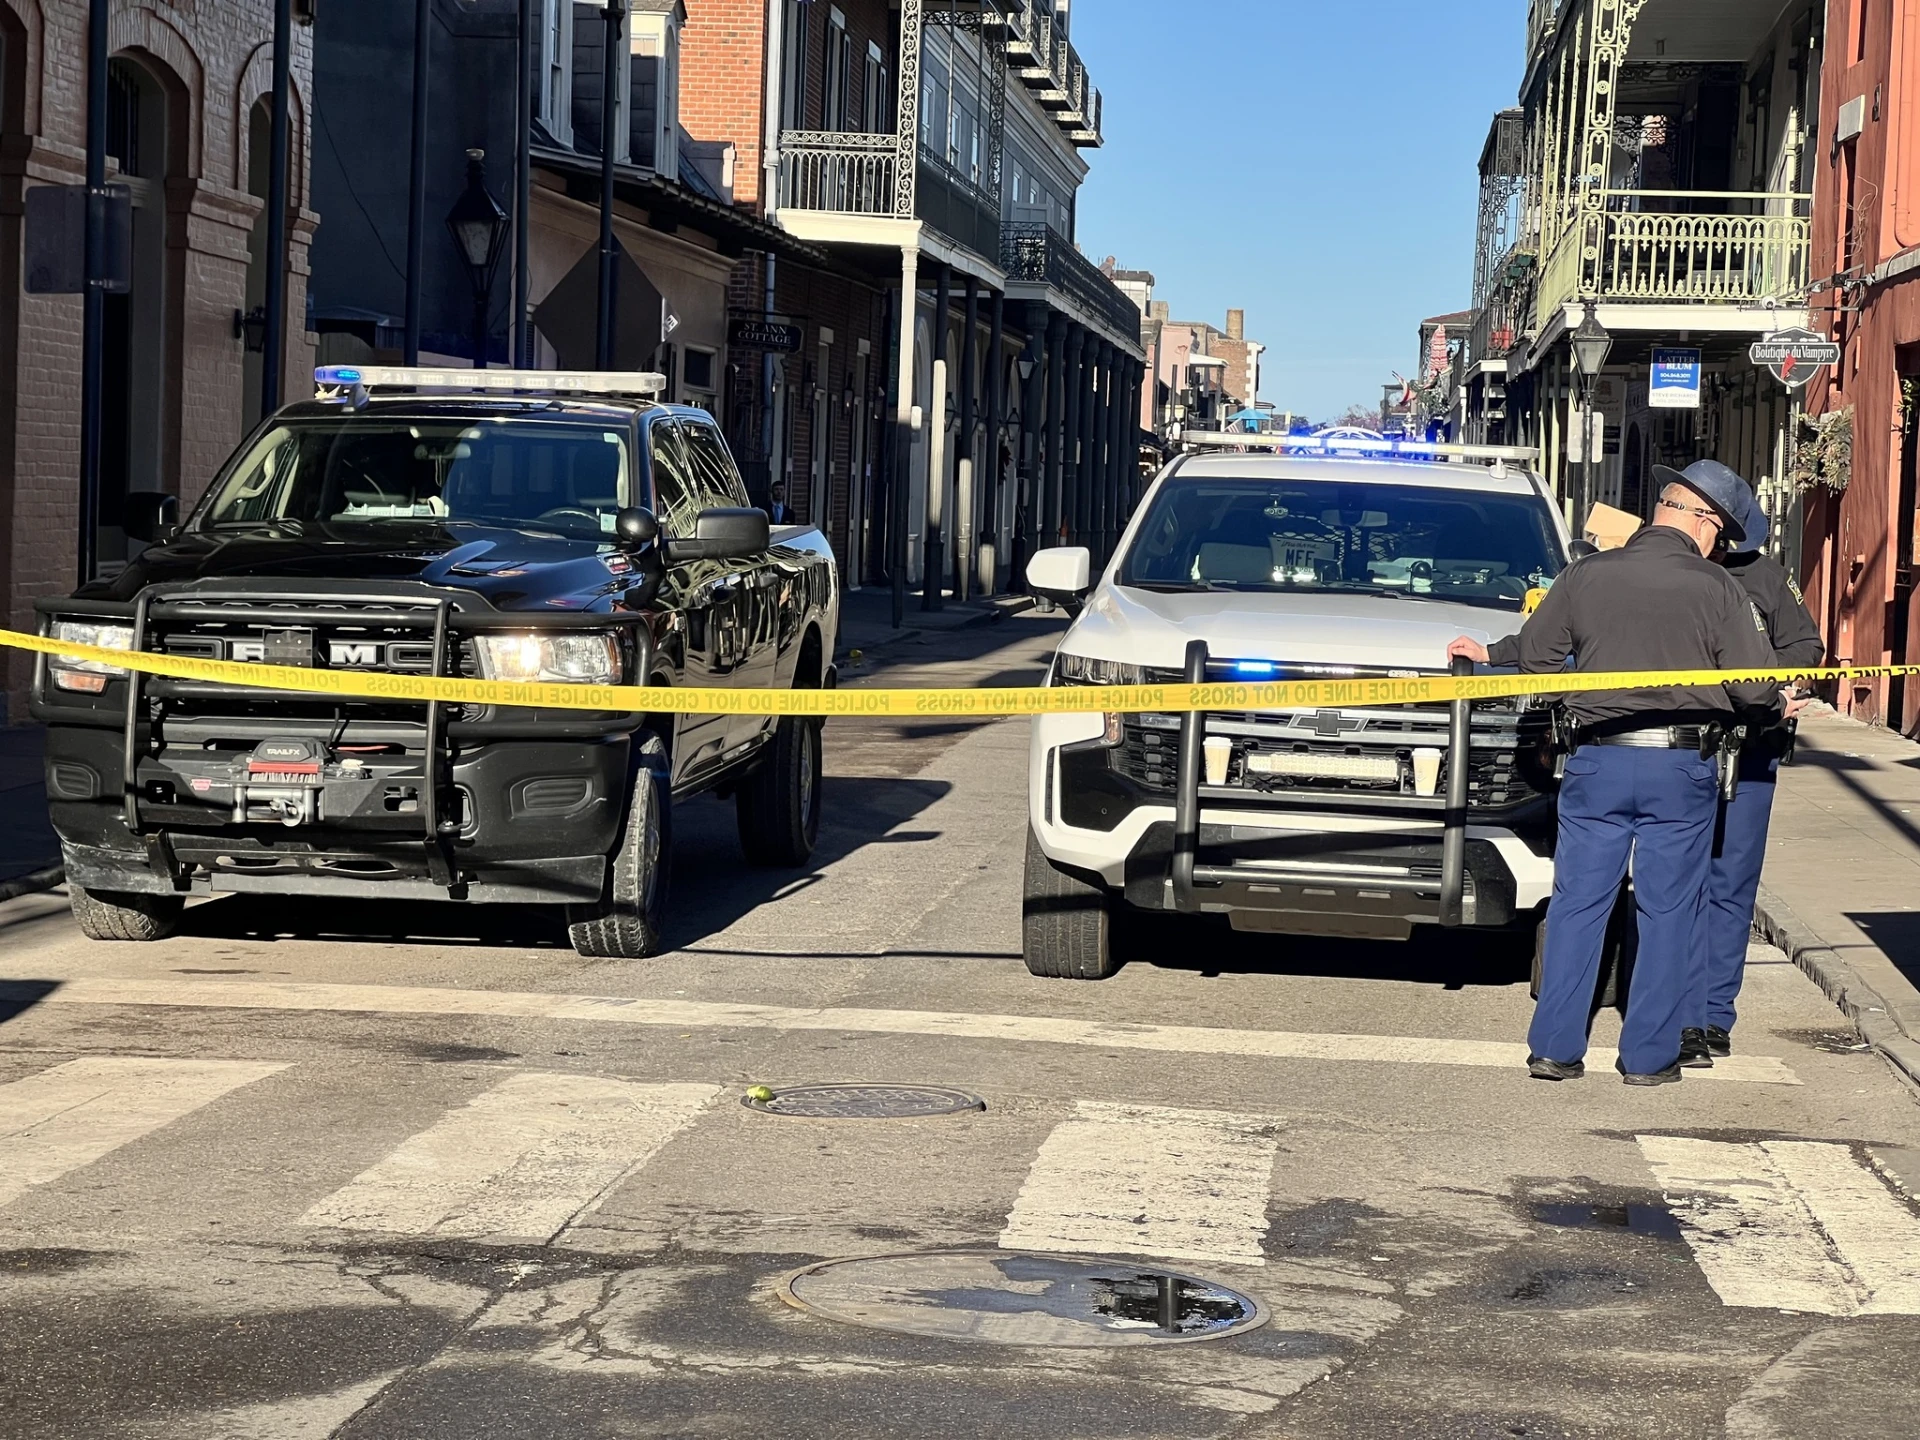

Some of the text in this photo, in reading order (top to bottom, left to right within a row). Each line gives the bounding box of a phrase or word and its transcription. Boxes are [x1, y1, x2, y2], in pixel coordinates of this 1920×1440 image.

[762, 324, 788, 335] ANN
[738, 330, 792, 344] COTTAGE
[1658, 355, 1696, 363] LATTER
[1755, 344, 1834, 362] Boutique du Vampyre
